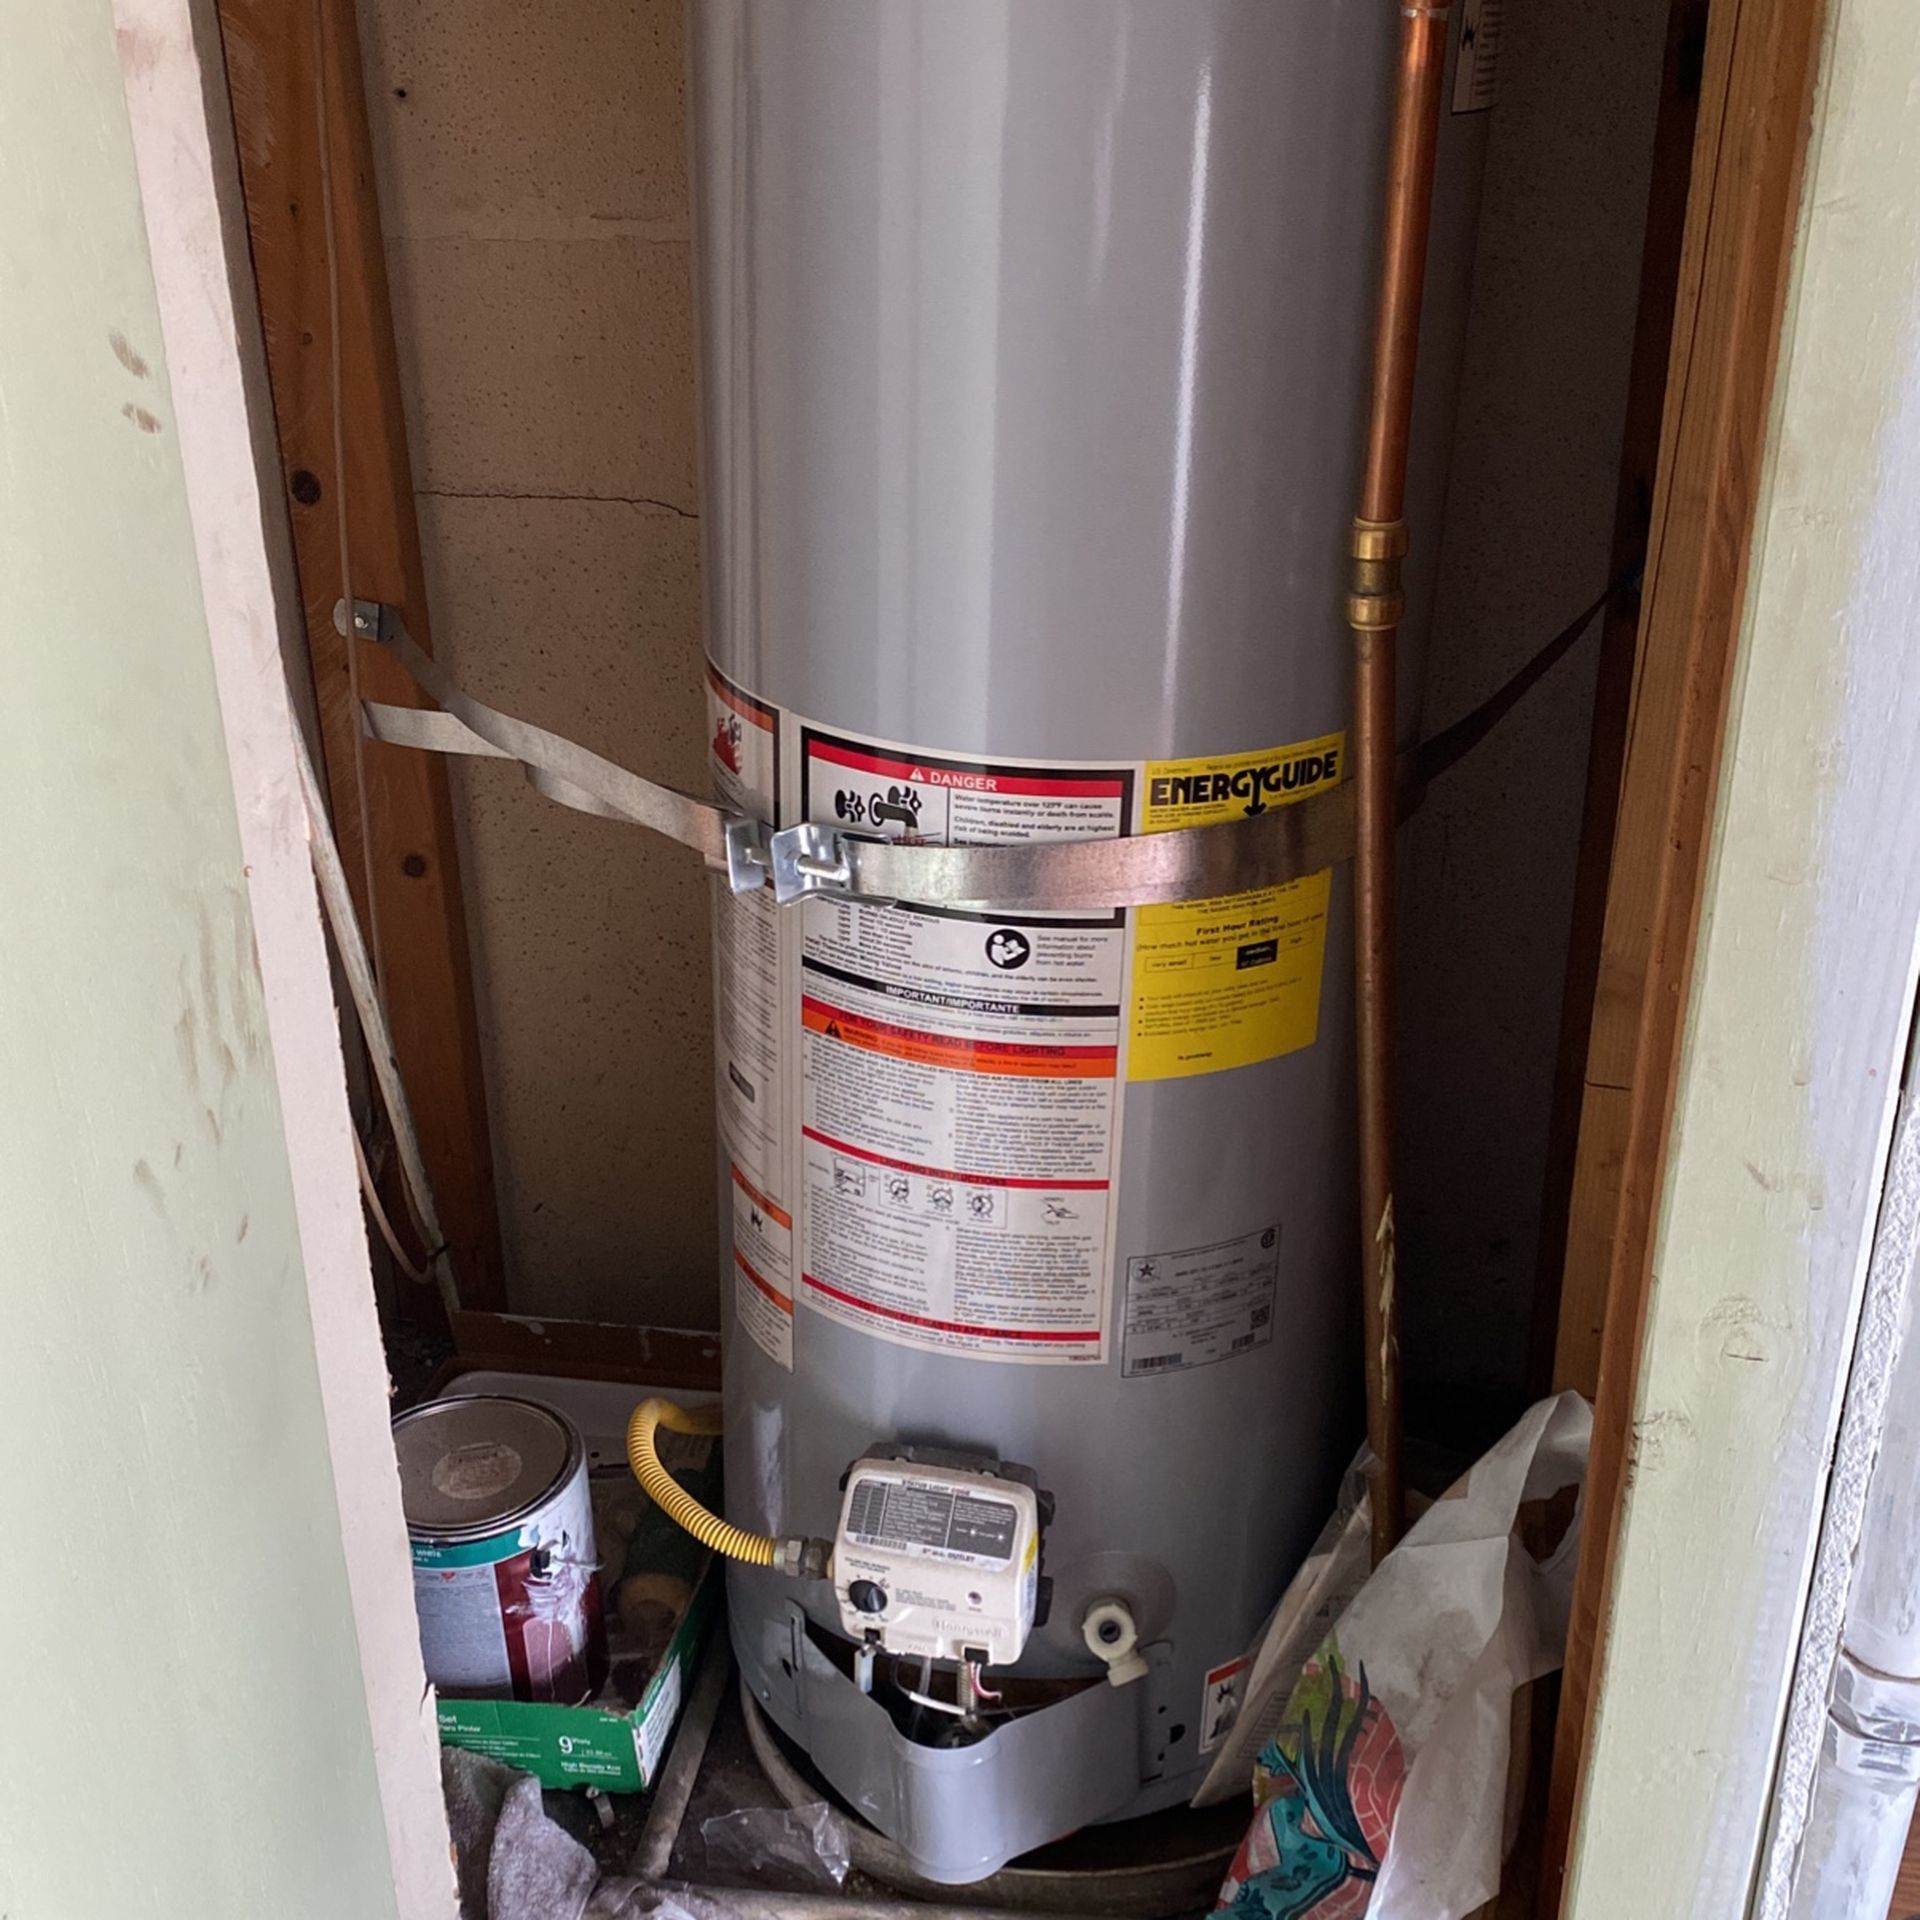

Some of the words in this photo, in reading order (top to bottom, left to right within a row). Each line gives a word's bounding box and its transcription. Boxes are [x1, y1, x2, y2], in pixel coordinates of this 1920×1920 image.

[930, 771, 998, 792] DANGER
[1150, 750, 1338, 808] ENERGYGUIDE
[1046, 810, 1068, 818] death
[1022, 822, 1035, 830] and
[1196, 926, 1220, 936] First
[1223, 922, 1248, 932] Hour
[1249, 915, 1280, 928] Rating
[886, 985, 1020, 1014] IMPORTANT/IMPORTANTE
[1012, 1046, 1065, 1056] LIGHTING
[933, 1619, 1003, 1637] Honeywell
[558, 1735, 573, 1754] 9
